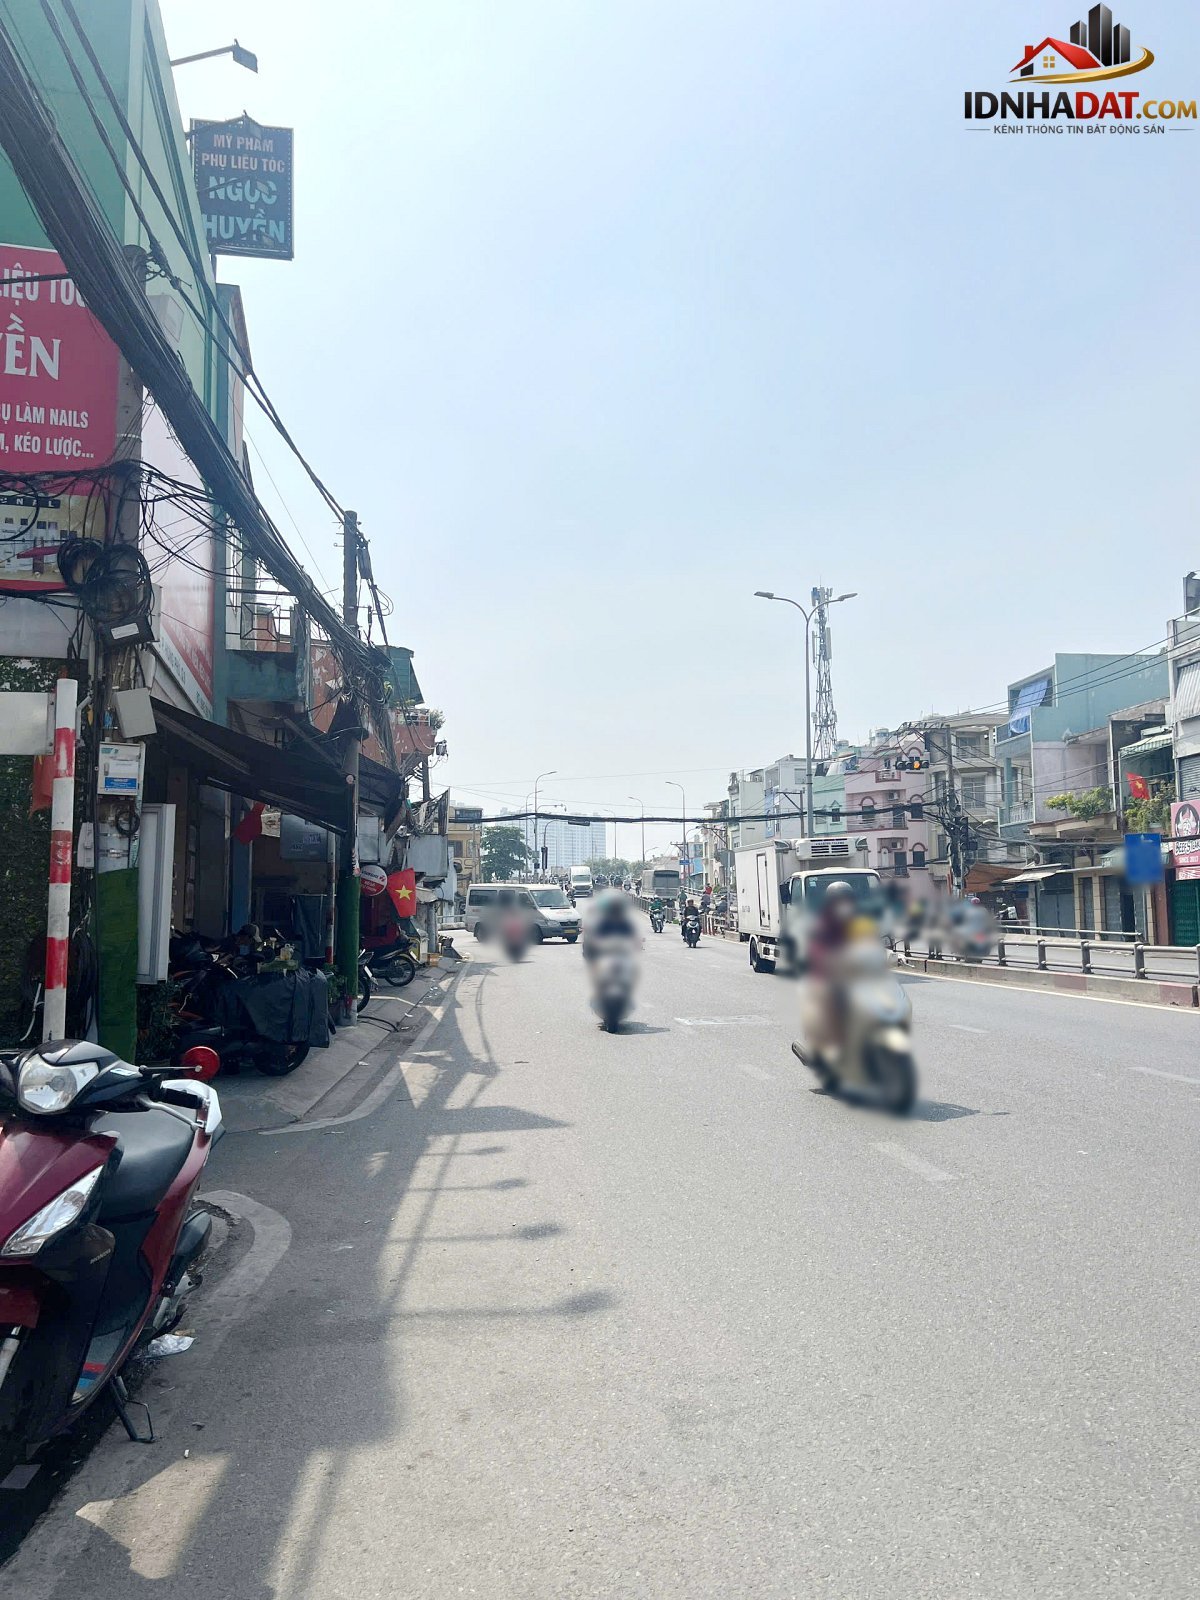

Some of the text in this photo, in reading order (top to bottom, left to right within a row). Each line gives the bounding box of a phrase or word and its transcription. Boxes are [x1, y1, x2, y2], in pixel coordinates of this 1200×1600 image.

[201, 153, 227, 170] PHỤ
[261, 156, 285, 173] TÓC
[209, 176, 277, 209] NGỌC
[0, 262, 40, 306] IỆU
[0, 312, 62, 381] ỀN
[0, 401, 89, 429] Ụ LÀM NAILS
[14, 431, 41, 454] KÉO
[45, 436, 95, 460] LƯỢC...
